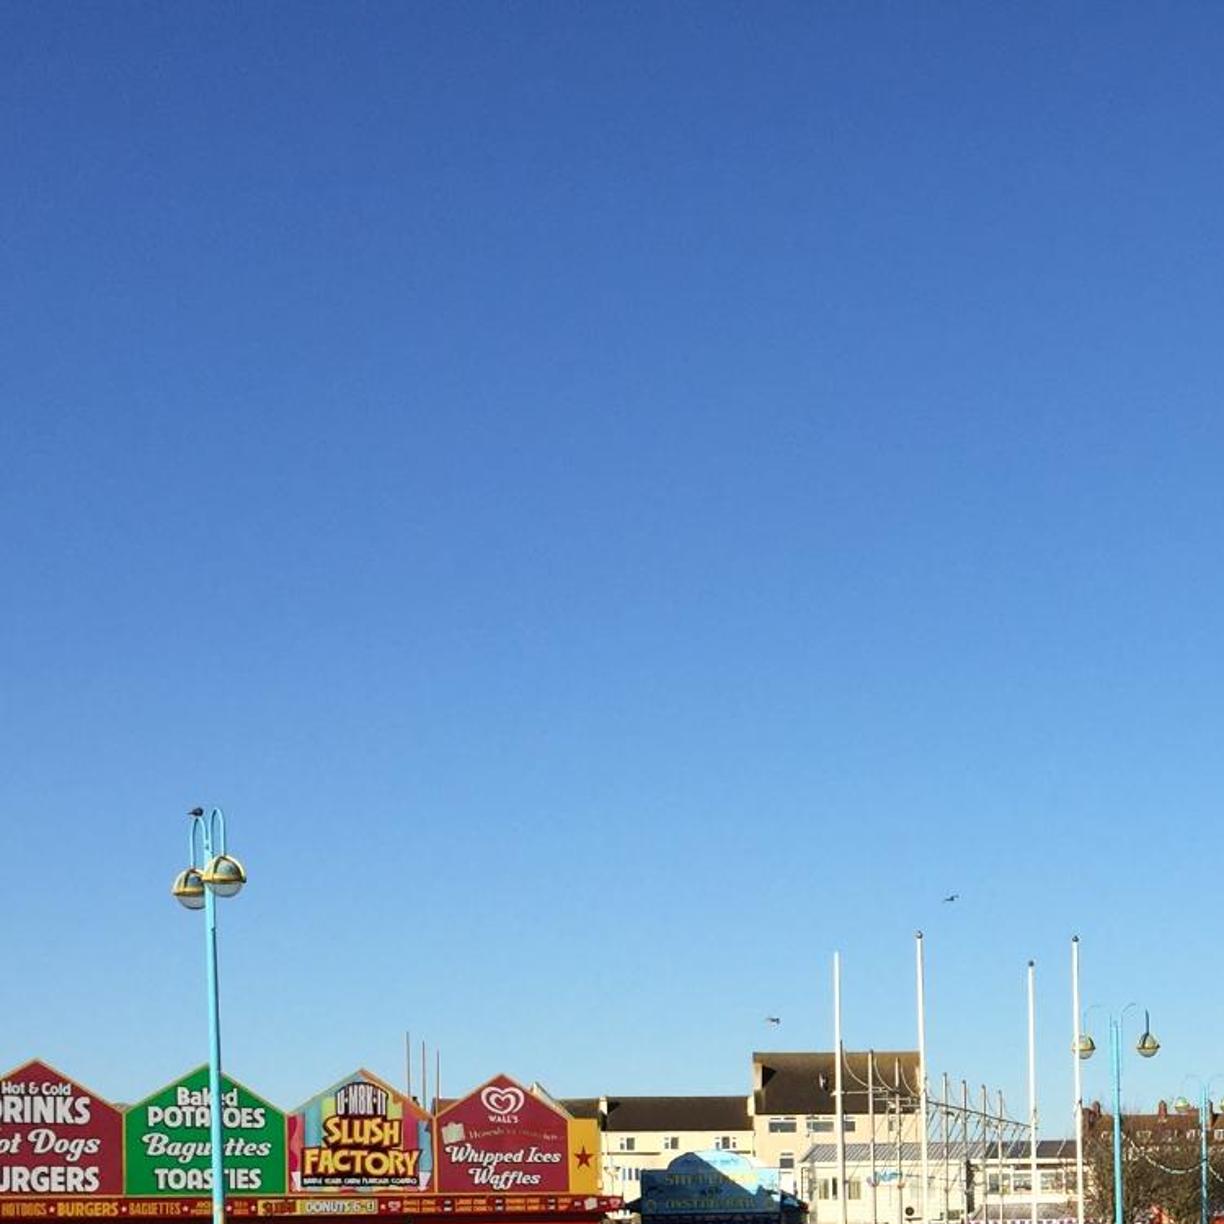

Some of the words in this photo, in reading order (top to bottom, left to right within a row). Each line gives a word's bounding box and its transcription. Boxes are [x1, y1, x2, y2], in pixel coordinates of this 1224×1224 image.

[2, 1081, 25, 1094] Hot
[29, 1082, 39, 1094] &
[42, 1082, 71, 1095] Cold
[0, 1096, 91, 1124] RINKS
[147, 1106, 266, 1129] POTAOES
[325, 1116, 400, 1146] SLUSH
[0, 1132, 21, 1154] ot
[27, 1128, 101, 1162] Dogs
[142, 1132, 272, 1163] Baguttes
[445, 1143, 525, 1166] Whipped
[526, 1146, 561, 1163] Ices
[304, 1149, 420, 1176] FACTORY
[155, 1167, 262, 1190] TOASIES
[468, 1165, 541, 1191] Waffles
[57, 1202, 119, 1217] BURGERS
